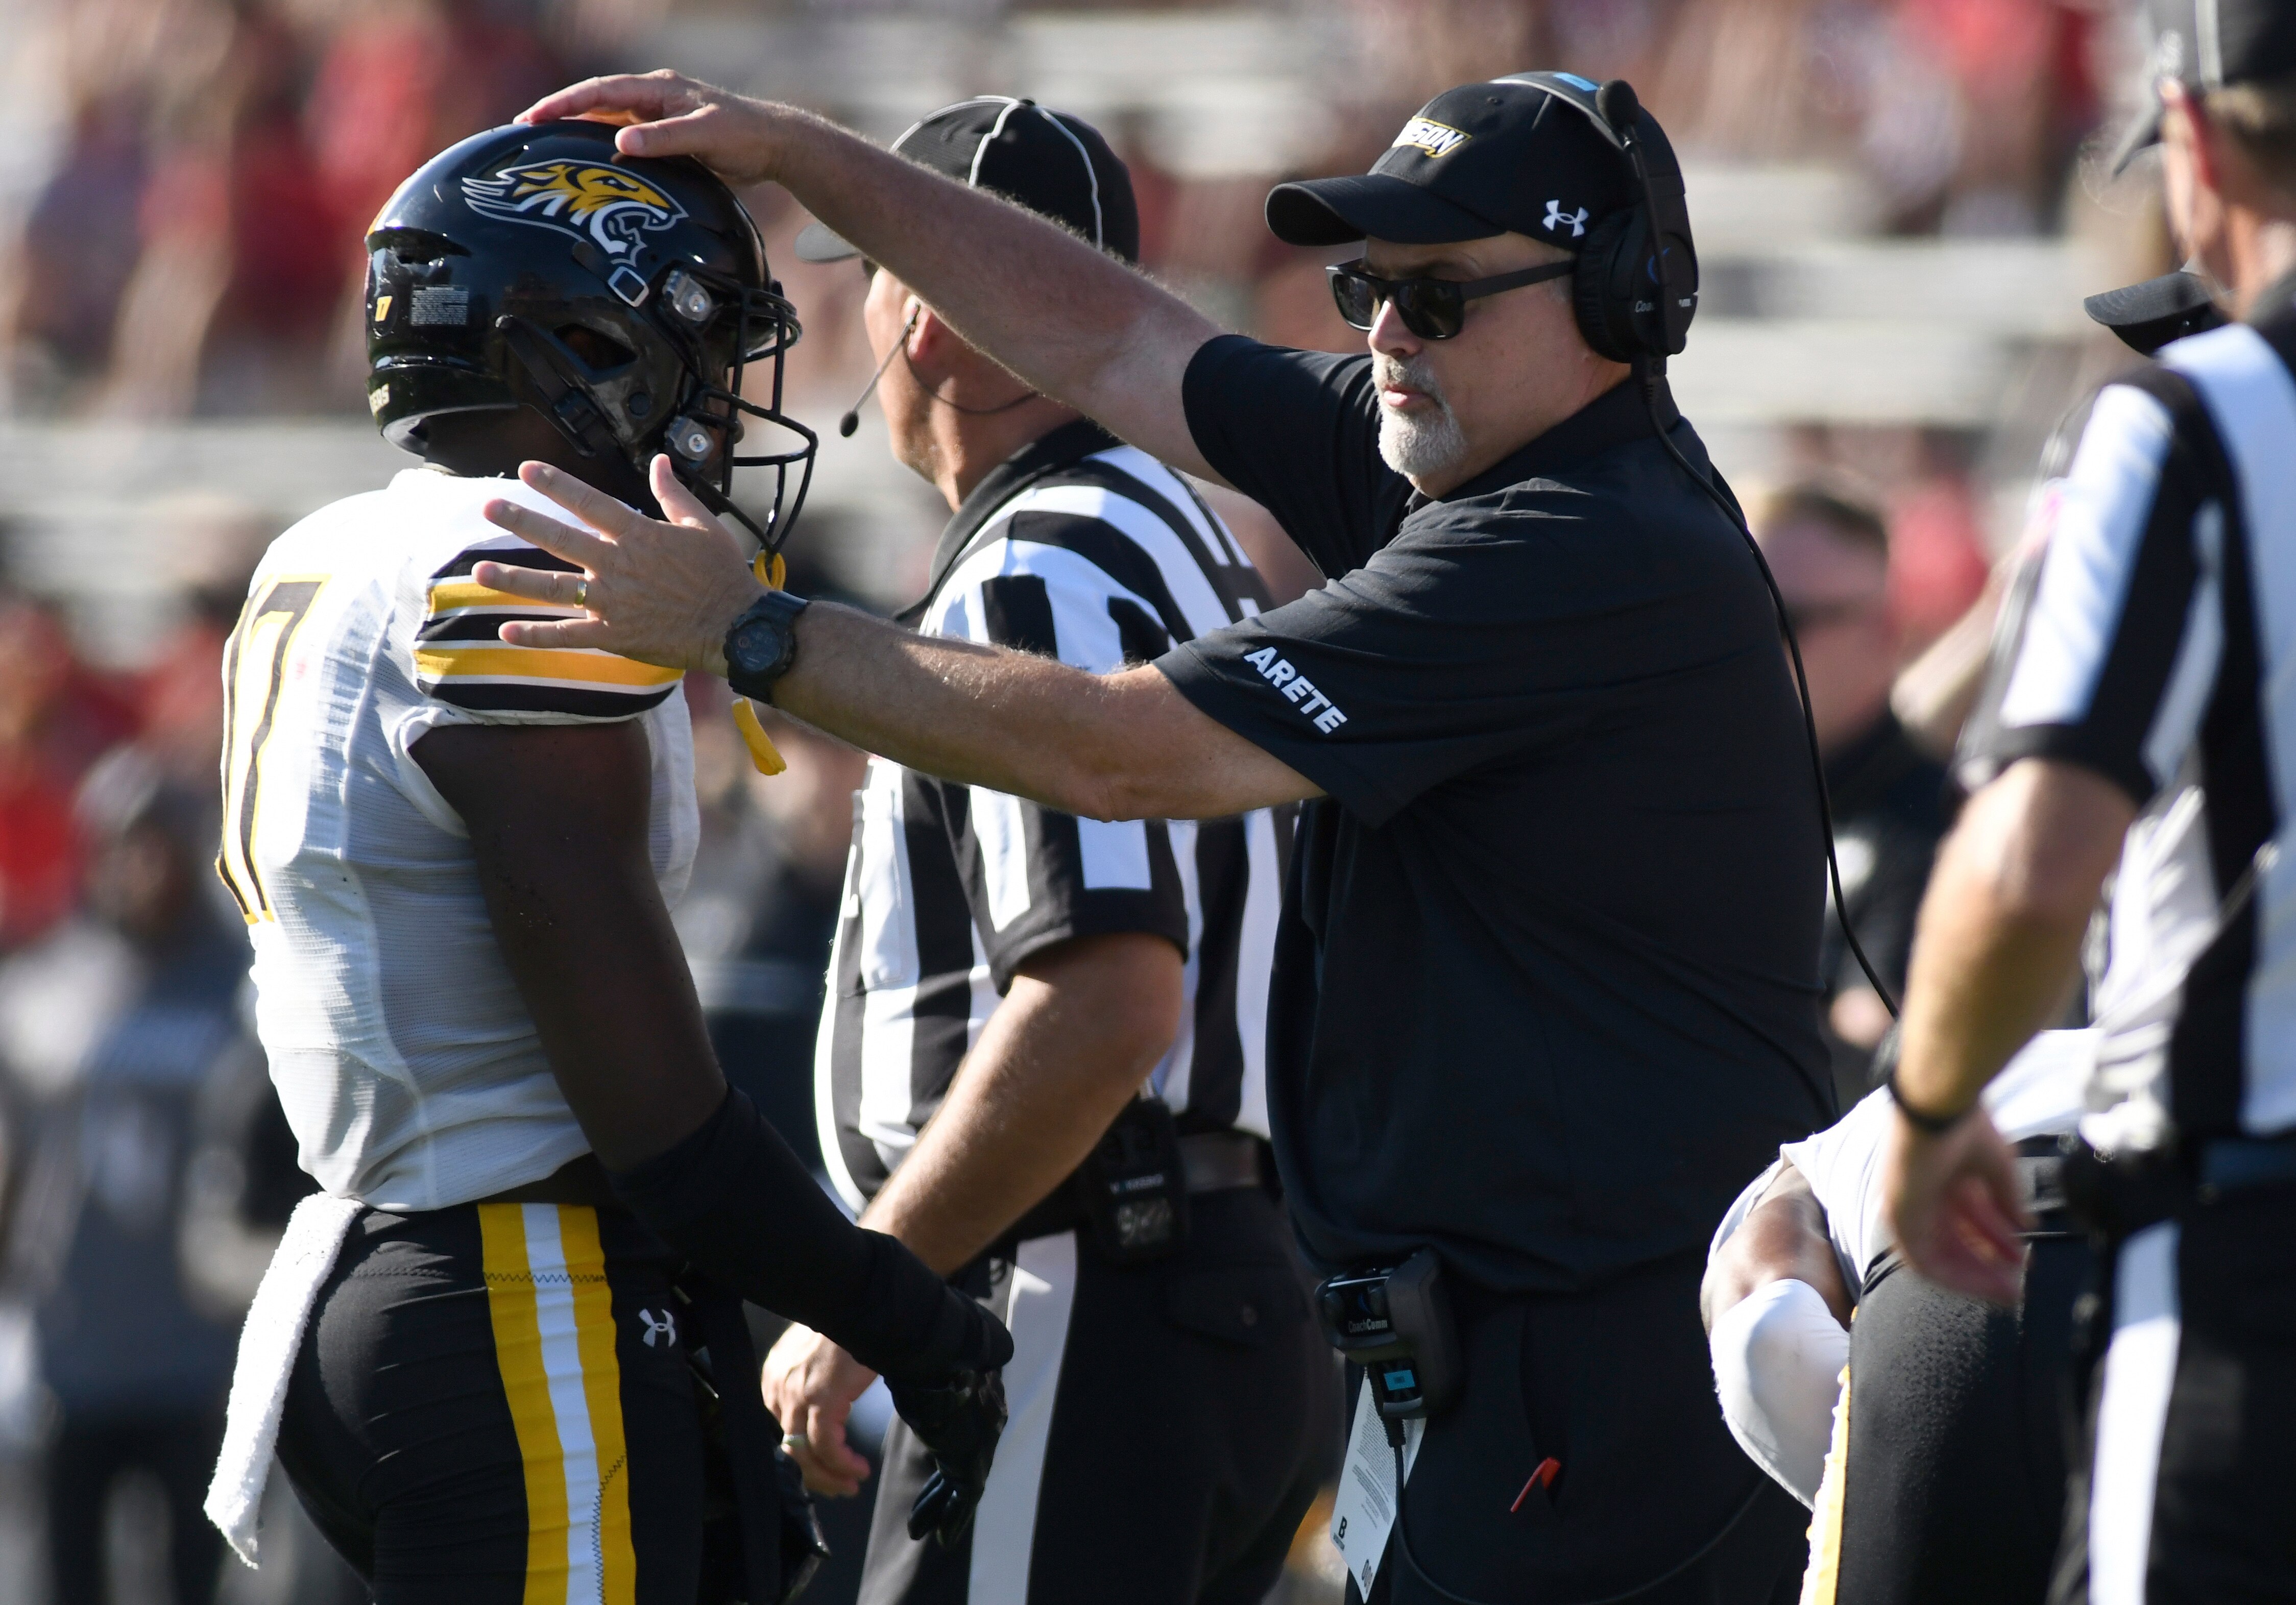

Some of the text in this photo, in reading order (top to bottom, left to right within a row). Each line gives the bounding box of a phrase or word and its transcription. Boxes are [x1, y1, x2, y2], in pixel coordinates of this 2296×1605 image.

[1244, 646, 1348, 734] ARETE
[215, 573, 332, 923] 17
[1338, 1516, 1347, 1539] B
